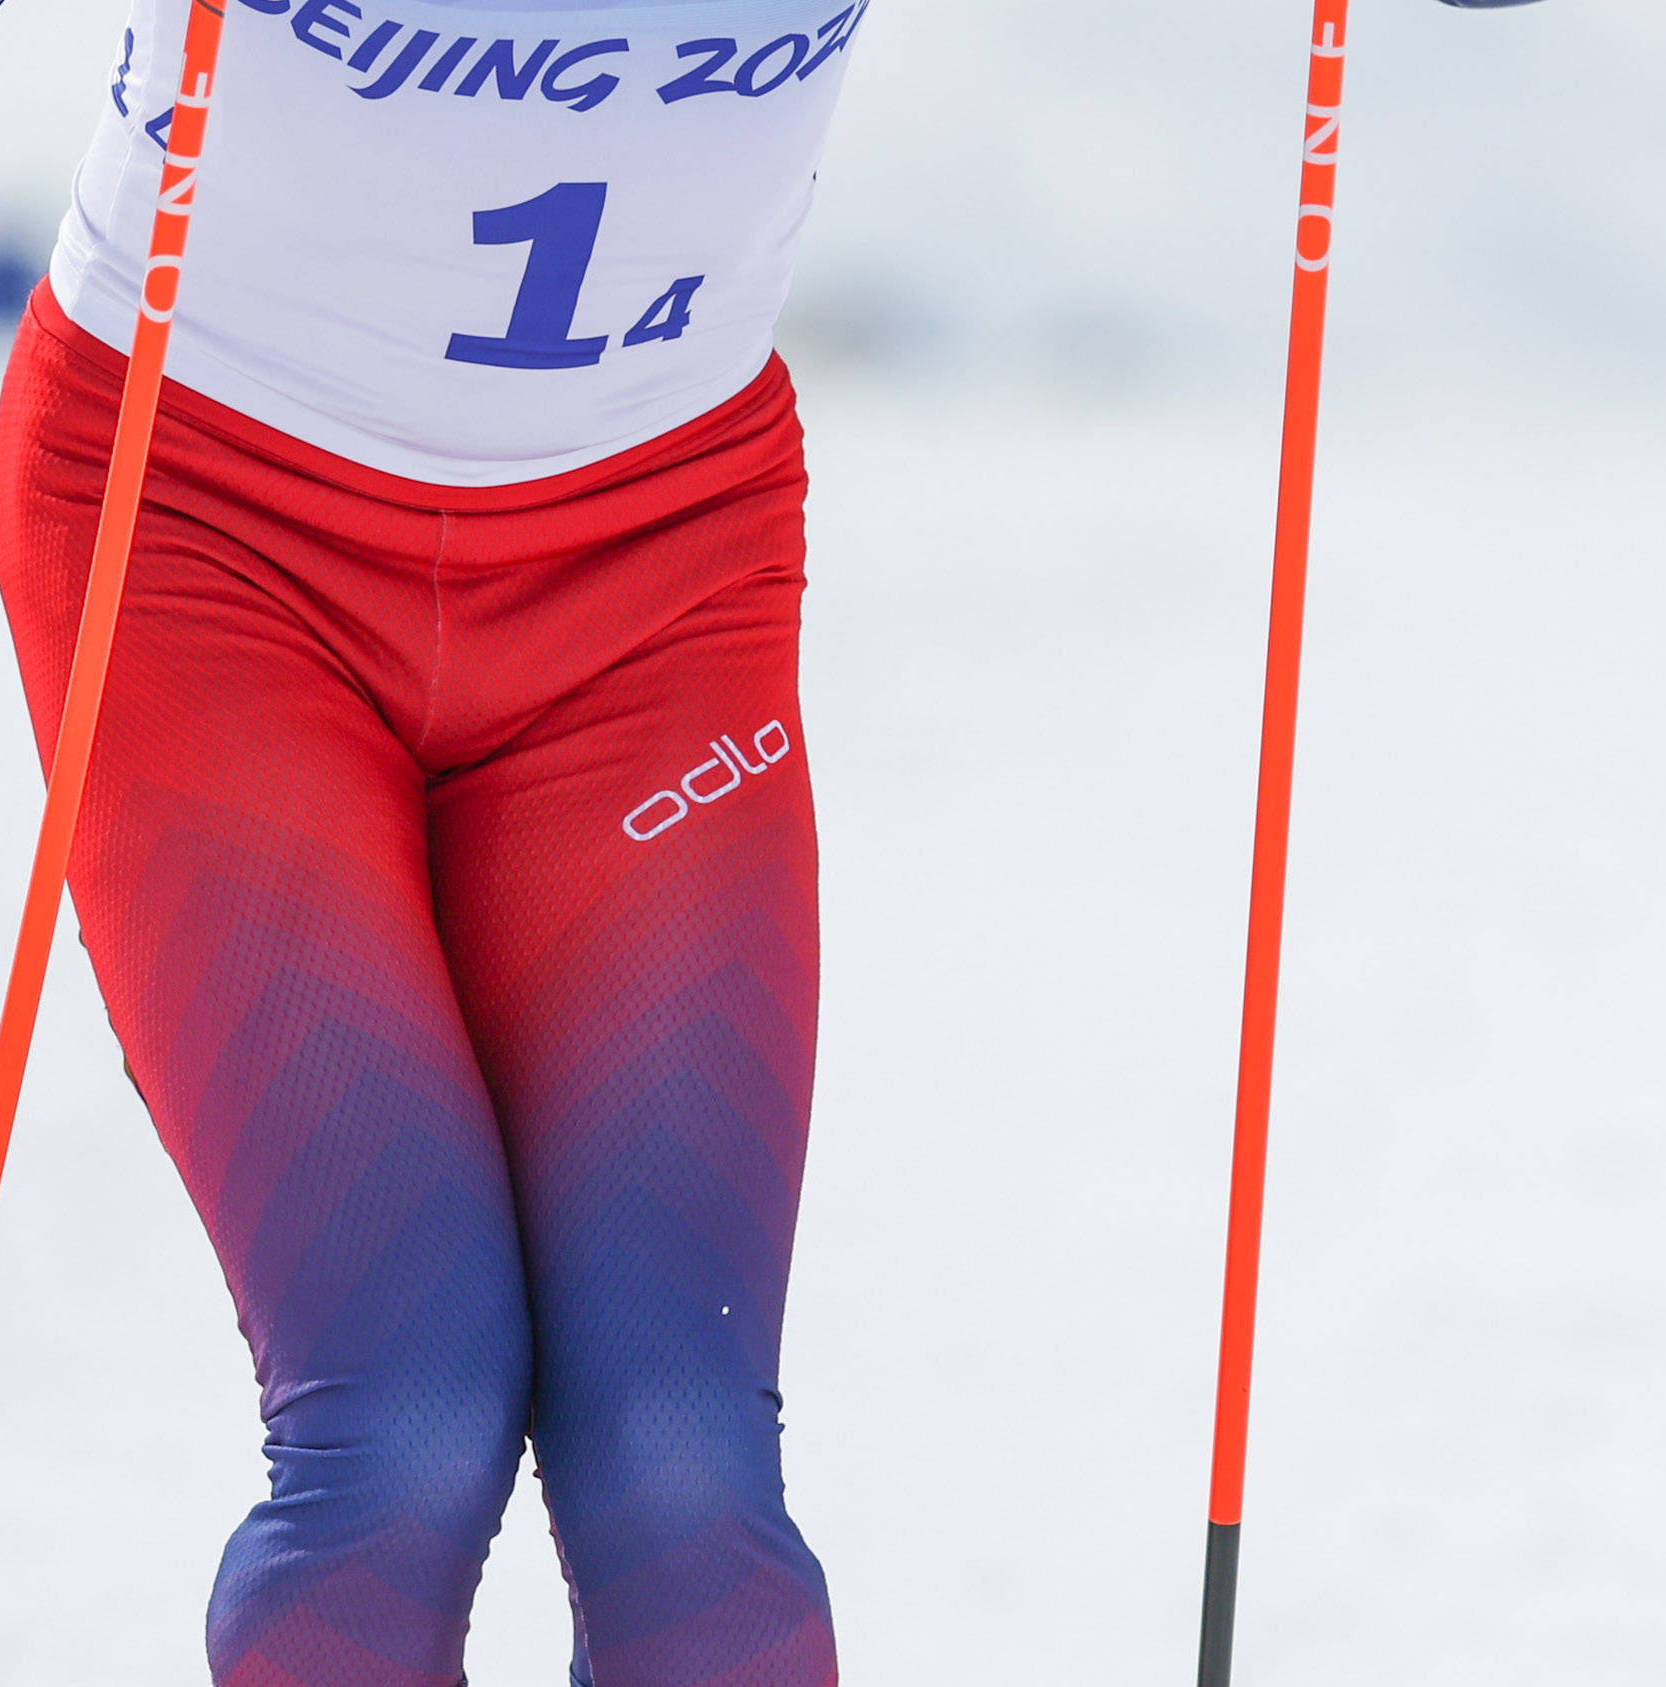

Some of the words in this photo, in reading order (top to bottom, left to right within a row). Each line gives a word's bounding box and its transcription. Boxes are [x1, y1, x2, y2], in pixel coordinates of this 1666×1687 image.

[444, 181, 610, 370] 1
[621, 274, 706, 348] 4
[622, 719, 791, 842] odlo
